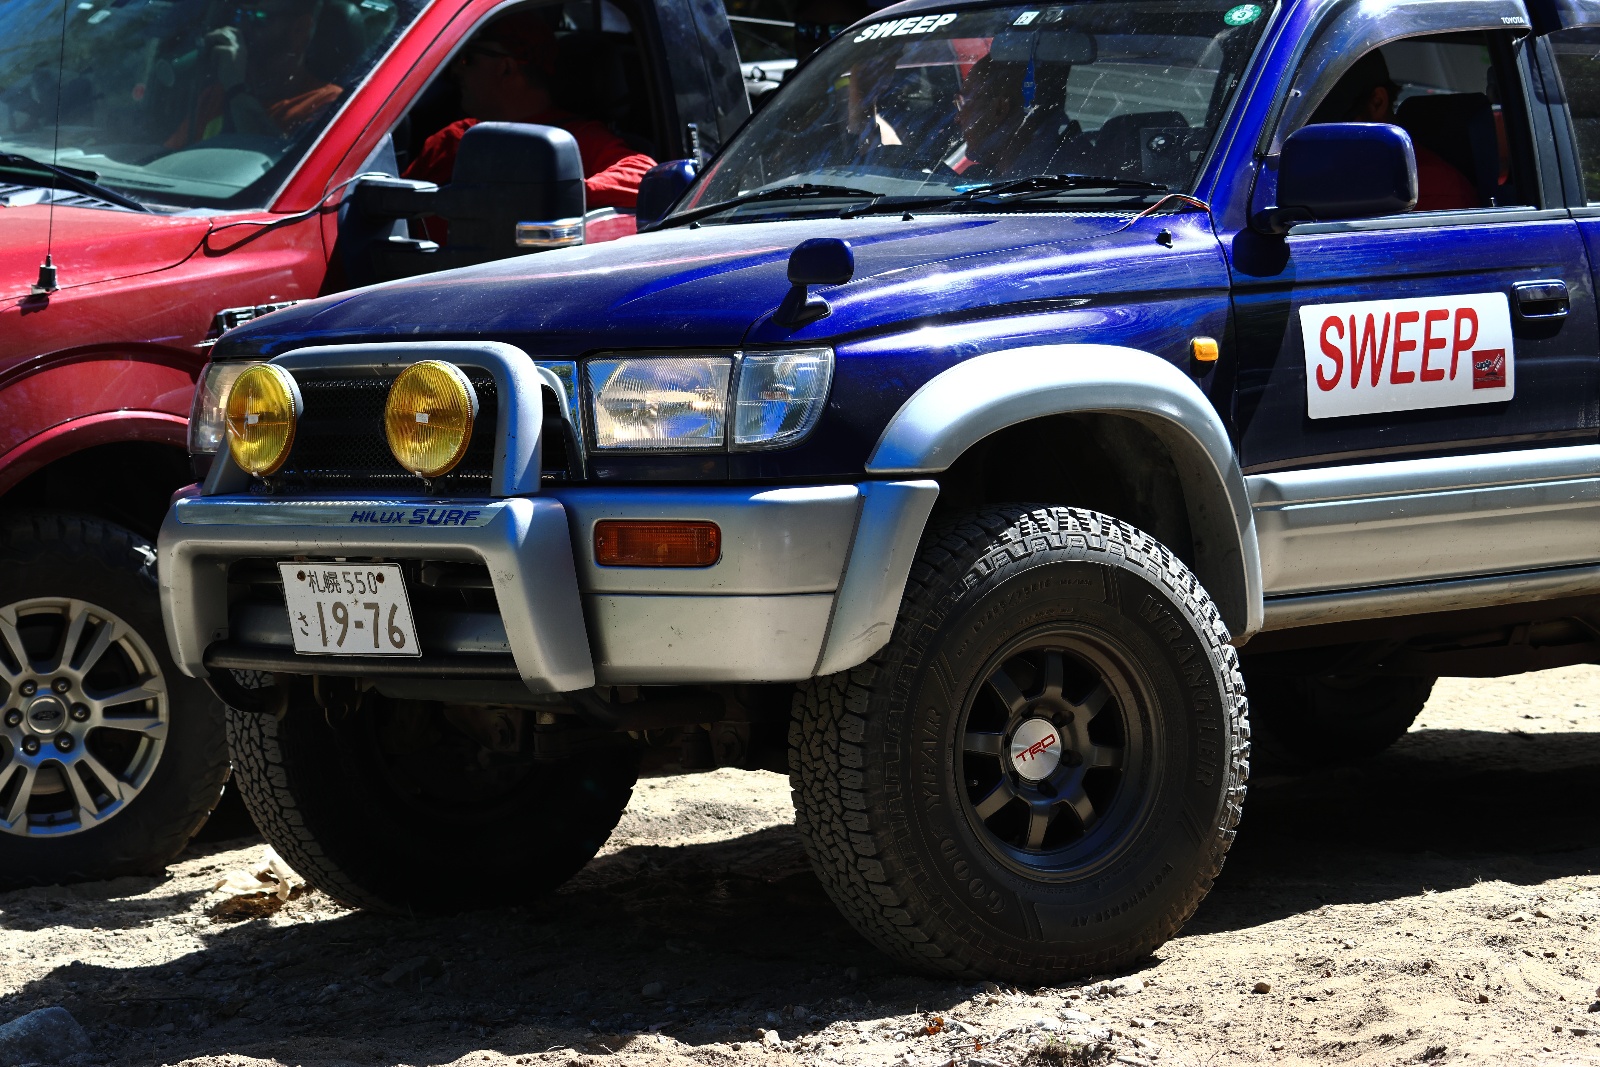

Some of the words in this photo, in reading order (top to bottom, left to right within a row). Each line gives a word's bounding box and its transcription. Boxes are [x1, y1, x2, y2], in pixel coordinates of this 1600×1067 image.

[853, 13, 958, 43] SWEEP
[1500, 16, 1525, 25] TOYOTA
[1316, 307, 1479, 392] SWEEP
[350, 510, 406, 524] HILUX
[408, 508, 481, 526] SURF
[307, 570, 341, 594] 札幌
[342, 571, 378, 595] 550
[298, 611, 309, 637] さ
[316, 601, 406, 650] 19-76
[1138, 594, 1218, 787] WRANGLER
[1015, 733, 1056, 762] TRD
